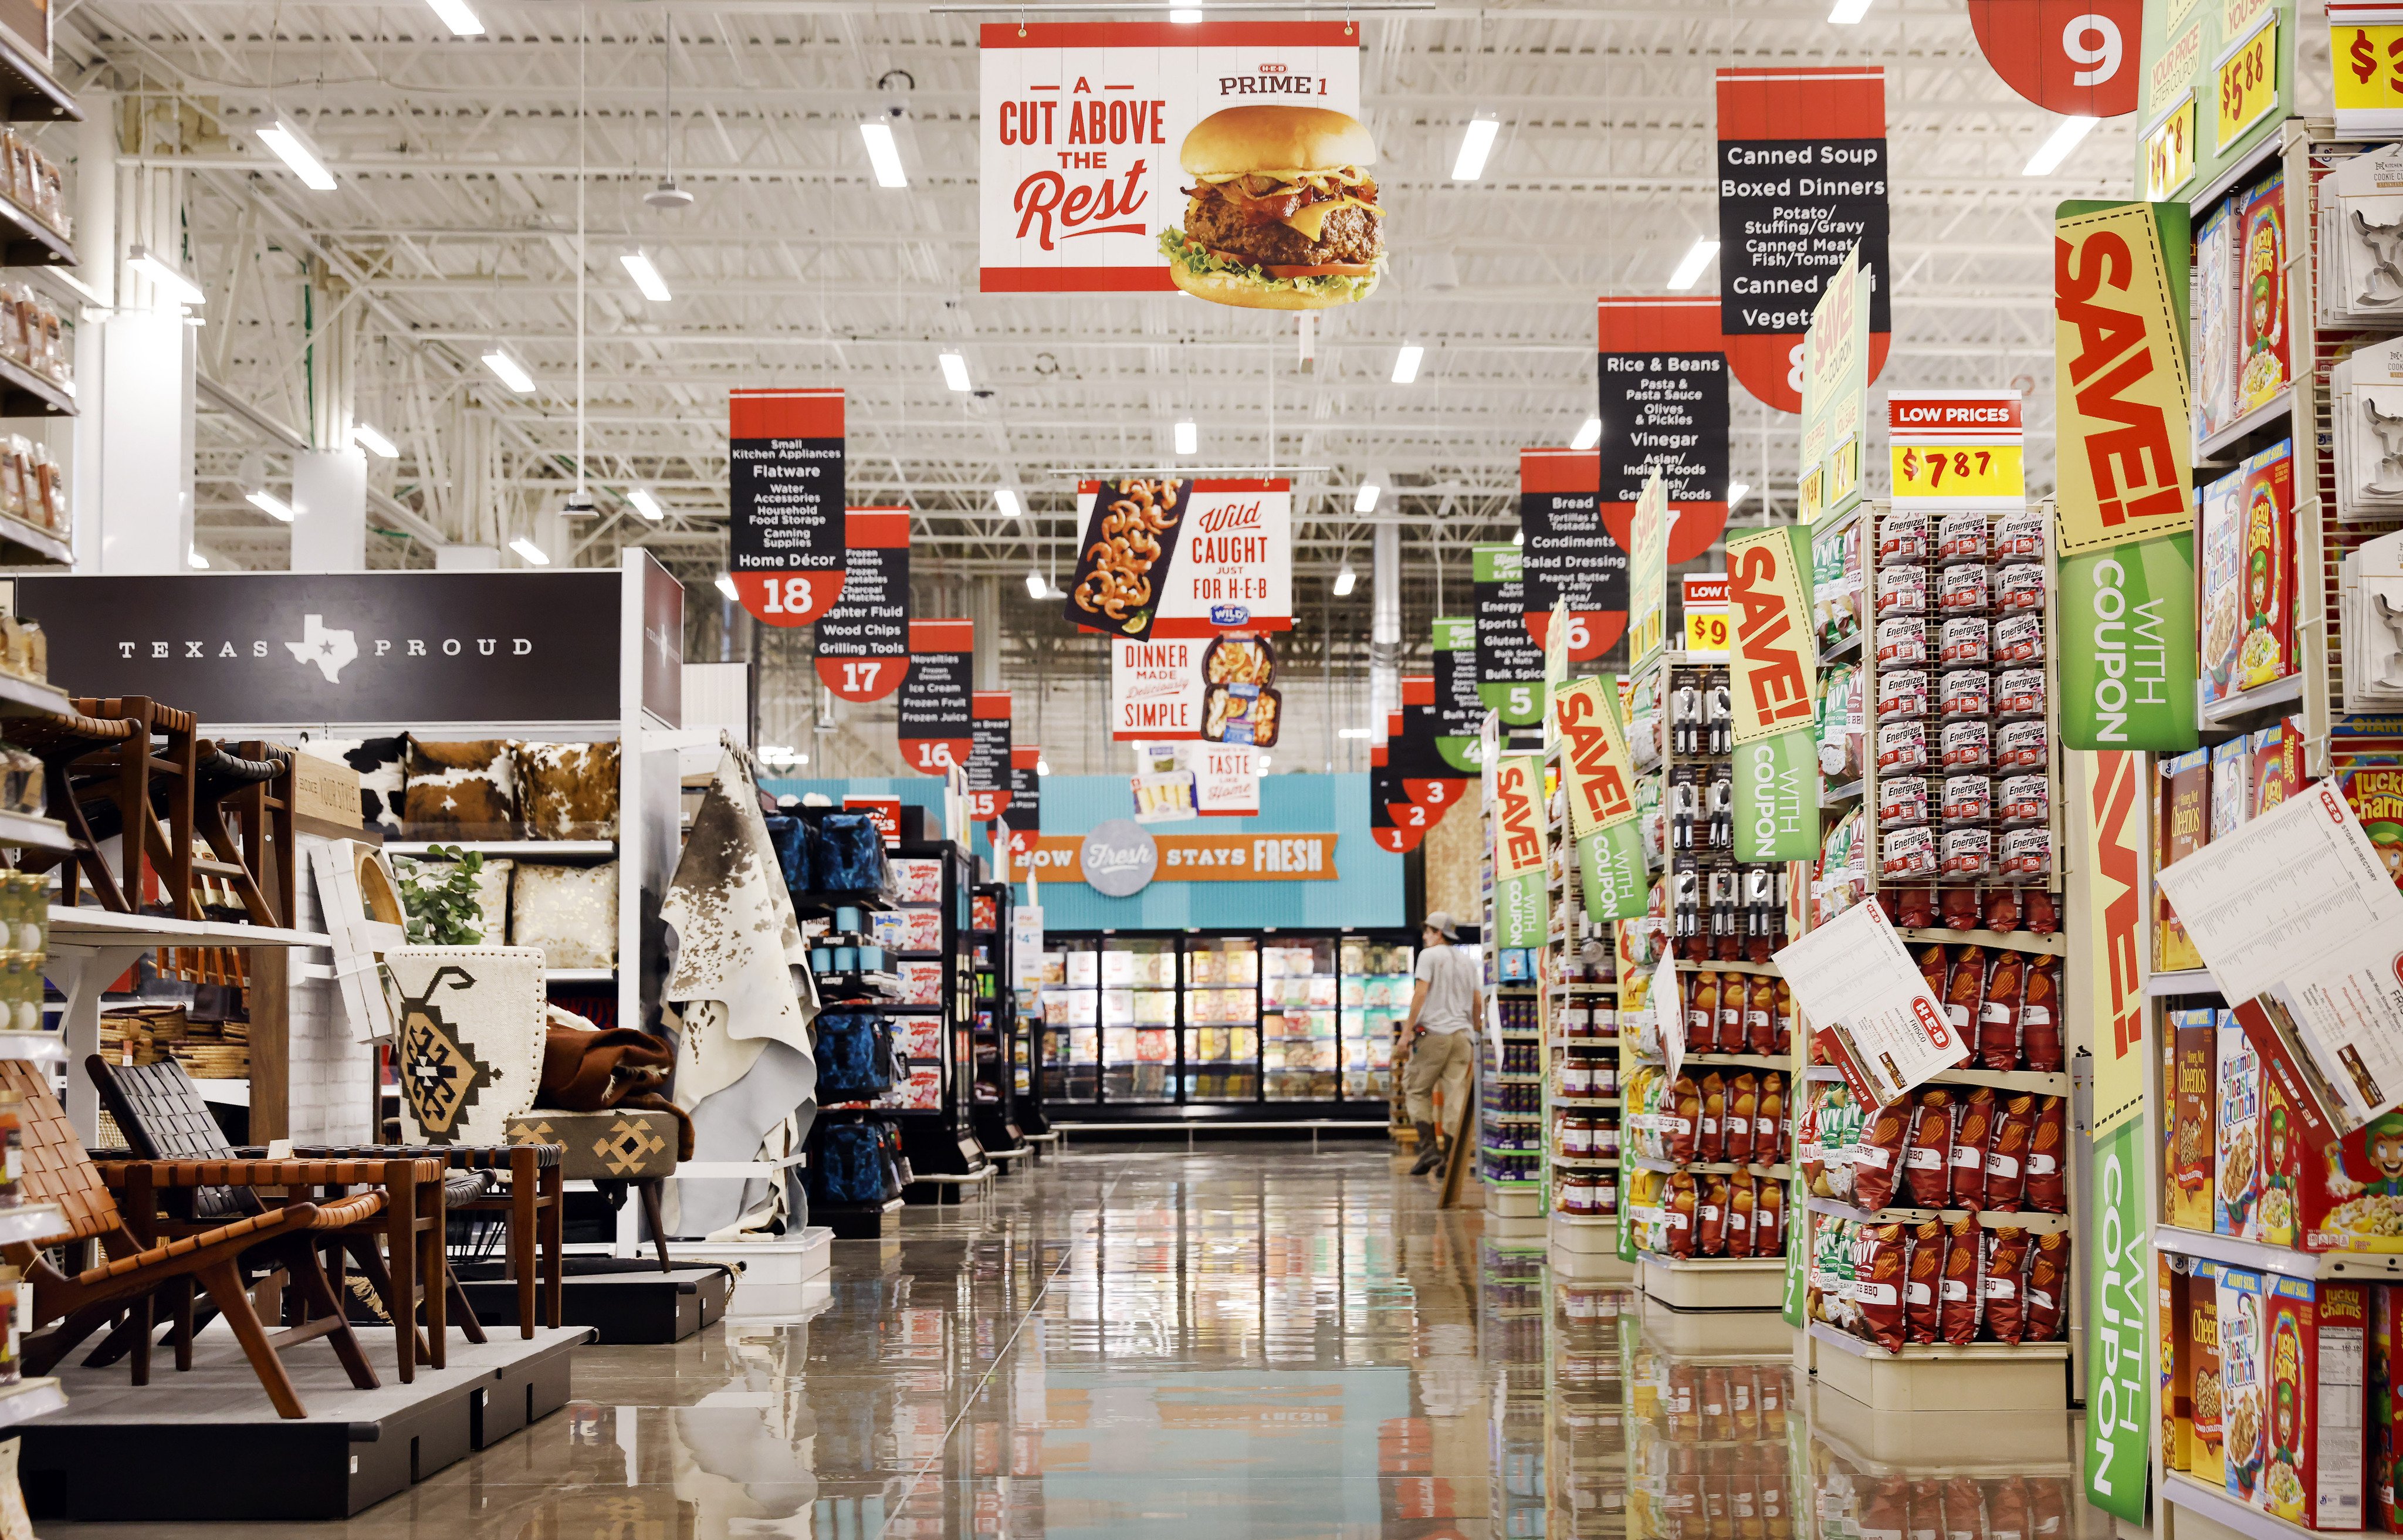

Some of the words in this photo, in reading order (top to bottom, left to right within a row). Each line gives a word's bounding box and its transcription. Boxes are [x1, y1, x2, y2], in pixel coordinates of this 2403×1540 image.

[2062, 13, 2123, 87] 9
[2152, 50, 2174, 90] YOUR
[1073, 77, 1091, 93] A
[1219, 76, 1311, 96] PRIME
[1318, 78, 1327, 95] 1
[2222, 42, 2263, 121] $588
[1000, 101, 1057, 145] CUT
[1068, 100, 1166, 144] ABOVE
[1057, 152, 1107, 169] THE
[1727, 146, 1812, 165] Canned
[1820, 145, 1878, 166] Soup
[1721, 179, 1792, 198] Boxed
[1799, 178, 1886, 197] Dinners
[1013, 158, 1148, 251] Rest
[1773, 204, 1837, 221] Potato/
[1745, 219, 1864, 236] Stuffing/Gravy
[1746, 238, 1810, 254] Canned
[1733, 276, 1819, 295] Canned
[1607, 358, 1644, 372] Rice
[1650, 357, 1662, 371] &
[1668, 357, 1720, 371] Beans
[1640, 379, 1676, 390] Pasta
[1678, 379, 1688, 389] &
[2055, 231, 2184, 527] SAVE!
[1626, 390, 1660, 401] Pasta
[1664, 390, 1703, 400] Sauce
[1644, 404, 1684, 415] Olives
[1900, 408, 1942, 421] LOW
[1946, 408, 2010, 422] PRICES
[1635, 415, 1644, 425] &
[1648, 414, 1693, 425] Pickles
[771, 439, 802, 449] Small
[1630, 432, 1699, 449] Vinegar
[733, 449, 775, 459] Kitchen
[779, 449, 841, 460] Appliances
[1644, 453, 1686, 465] Asian/
[753, 465, 820, 478] Flatware
[1667, 464, 1706, 475] Foods
[770, 484, 804, 493] Water
[1672, 489, 1711, 500] Foods
[754, 493, 820, 503] Accessories
[1552, 496, 1593, 509] Bread
[757, 506, 817, 515] Household
[1199, 501, 1261, 533] Wild
[1547, 513, 1589, 523] Tortillas
[1591, 512, 1599, 522] &
[749, 515, 779, 525] Food
[781, 515, 825, 525] Storage
[1550, 522, 1596, 531] Tostadas
[1889, 517, 1925, 531] Energizer
[2006, 519, 2043, 532] Energizer
[764, 529, 810, 539] Canning
[1532, 536, 1616, 548] Condiments
[763, 538, 811, 549] Supplies
[1192, 537, 1267, 564] CAUGHT
[739, 554, 784, 567] Home
[790, 553, 835, 567] Décor
[845, 549, 878, 557] Frozen
[1522, 556, 1561, 568] Salad
[1565, 555, 1626, 569] Dressing
[845, 567, 878, 576] Frozen
[1539, 573, 1575, 583] Peanut
[1578, 573, 1610, 581] Butter
[1948, 569, 1982, 585] Energizer
[841, 585, 882, 594] Charcoal
[1193, 578, 1221, 600] FOR
[1229, 578, 1267, 600] H-E-B
[1557, 582, 1566, 591] &
[1568, 582, 1592, 591] Jelly
[1691, 587, 1721, 598] LOW
[763, 578, 813, 614] 18
[838, 593, 845, 601] &
[847, 594, 886, 602] Matches
[871, 605, 903, 617] Fluid
[1481, 601, 1524, 614] Energy
[1570, 602, 1602, 610] Sauce
[823, 624, 861, 636] Wood
[865, 624, 901, 637] Chips
[1478, 618, 1518, 631] Sports
[1484, 635, 1524, 646] Gluten
[1567, 617, 1590, 649] 6
[1726, 546, 1812, 727] SAVE!
[119, 641, 269, 659] TEXAS
[374, 638, 533, 656] PROUD
[820, 642, 867, 655] Grilling
[870, 642, 904, 654] Tools
[1126, 645, 1187, 668] DINNER
[2093, 559, 2128, 742] COUPON
[2133, 598, 2166, 703] WITH
[911, 655, 959, 664] Novelties
[843, 662, 881, 692] 17
[1137, 671, 1177, 680] MADE
[1485, 669, 1512, 680] Bulk
[2005, 675, 2042, 690] Energizer
[909, 684, 925, 693] Ice
[927, 684, 960, 693] Cream
[903, 698, 939, 707] Frozen
[941, 698, 966, 707] Fruit
[1509, 687, 1532, 715] 5
[902, 712, 938, 722] Frozen
[940, 713, 967, 722] Juice
[1126, 704, 1188, 727] SIMPLE
[1443, 710, 1466, 720] Bulk
[919, 743, 950, 767] 16
[1557, 692, 1632, 823] SAVE!
[1209, 756, 1250, 776] TASTE
[1427, 783, 1444, 803] 3
[1888, 781, 1925, 796] Energizer
[1754, 745, 1776, 857] COUPON
[1778, 767, 1800, 833] WITH
[1409, 807, 1425, 827] 2
[1498, 767, 1542, 870] SAVE!
[2172, 807, 2200, 838] Cheerios
[1392, 830, 1403, 848] 1
[2012, 834, 2050, 849] Energizer
[1087, 844, 1152, 869] Fresh
[1166, 848, 1246, 866] STAYS
[1254, 839, 1322, 872] FRESH
[2341, 824, 2356, 848] STORE
[2354, 846, 2377, 882] DIRECTORY
[1592, 835, 1619, 919] COUPON
[1613, 849, 1635, 899] WITH
[1509, 880, 1523, 946] COUPON
[1522, 893, 1536, 933] WITH
[1879, 923, 1887, 936] STORE
[1887, 935, 1901, 956] DIRECTORY
[1915, 1001, 1947, 1044] H-E-B
[1909, 1019, 1926, 1043] FRISCO
[2179, 1061, 2206, 1094] Cheerios
[1864, 1284, 1878, 1298] BBQ
[2326, 1289, 2359, 1302] Lucky
[2320, 1301, 2362, 1319] Charms
[2094, 1153, 2122, 1497] COUPON
[2120, 1231, 2145, 1433] WITH
[2223, 1316, 2253, 1343] Cinnamon
